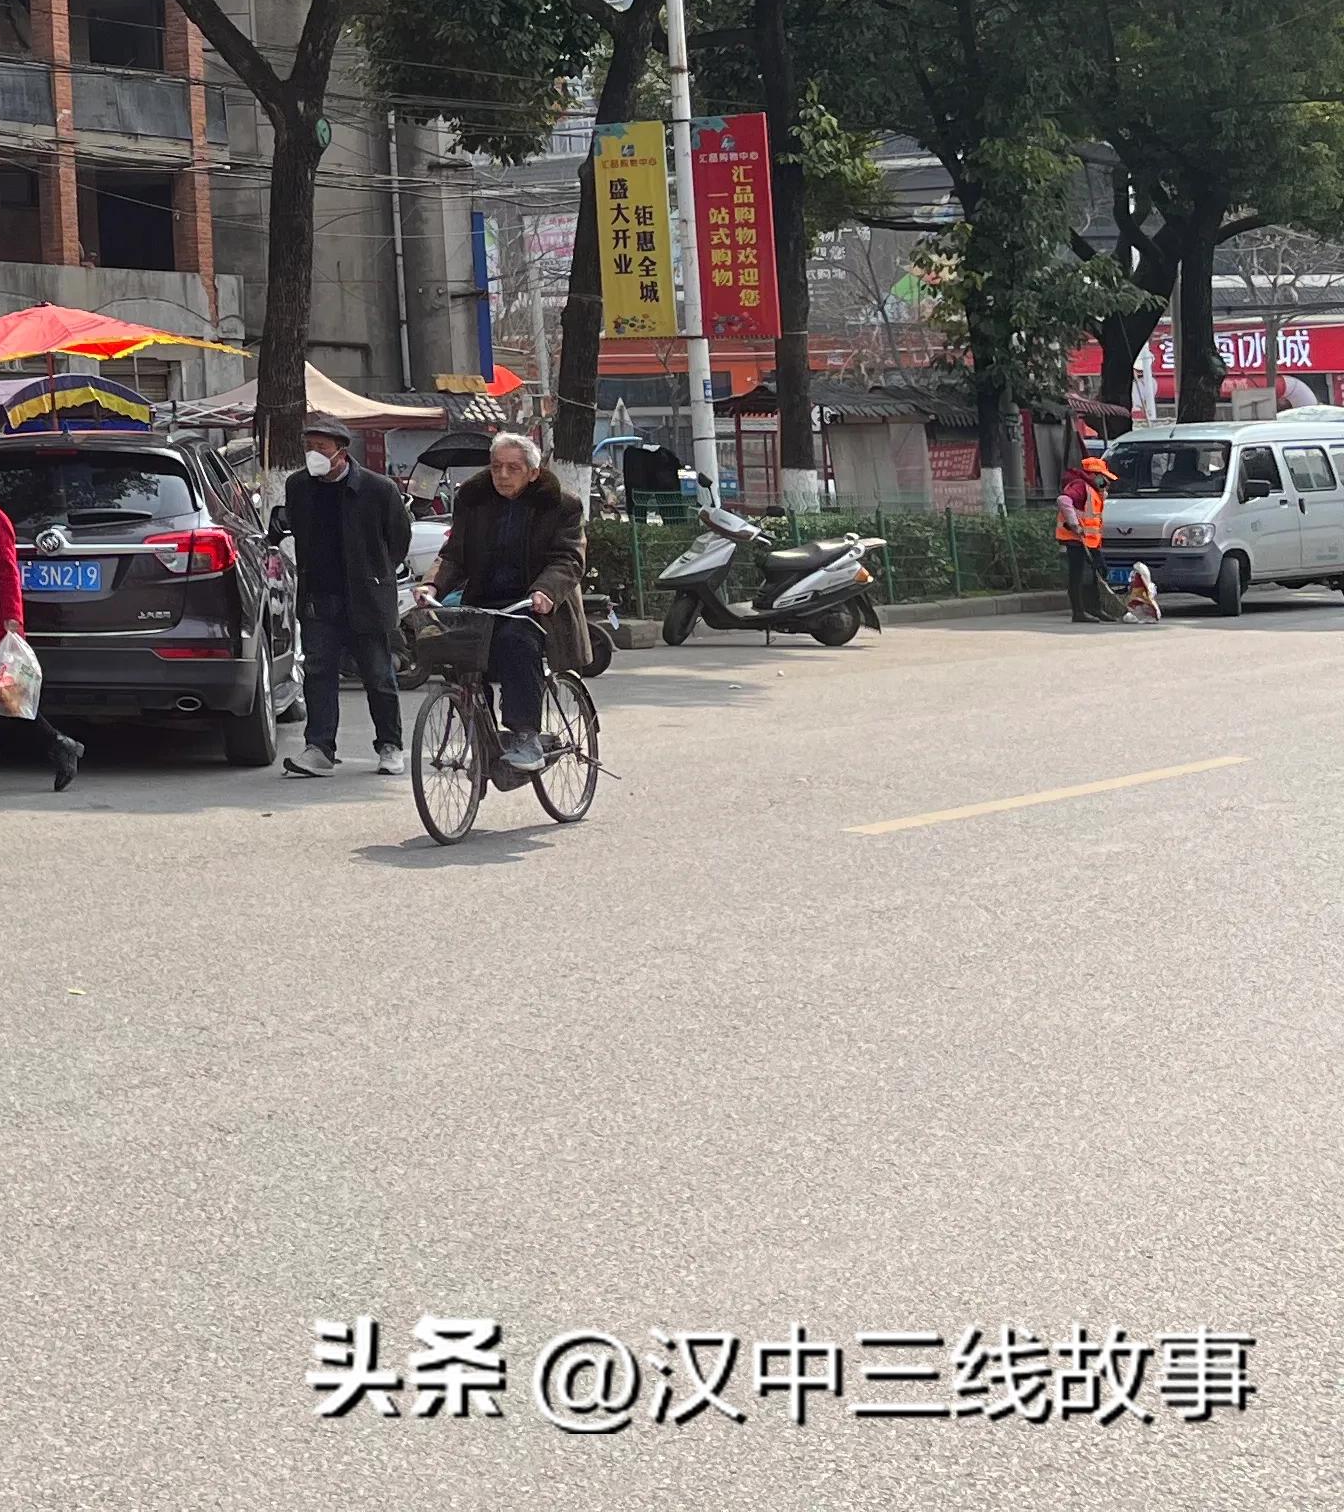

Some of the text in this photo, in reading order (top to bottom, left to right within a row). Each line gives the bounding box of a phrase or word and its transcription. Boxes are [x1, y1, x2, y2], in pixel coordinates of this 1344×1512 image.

[609, 178, 633, 276] 盛大开业
[634, 205, 659, 303] 钜惠全城
[707, 191, 734, 287] 一站式购物
[731, 164, 761, 307] 汇品购物欢迎您
[20, 565, 98, 587] F3N219
